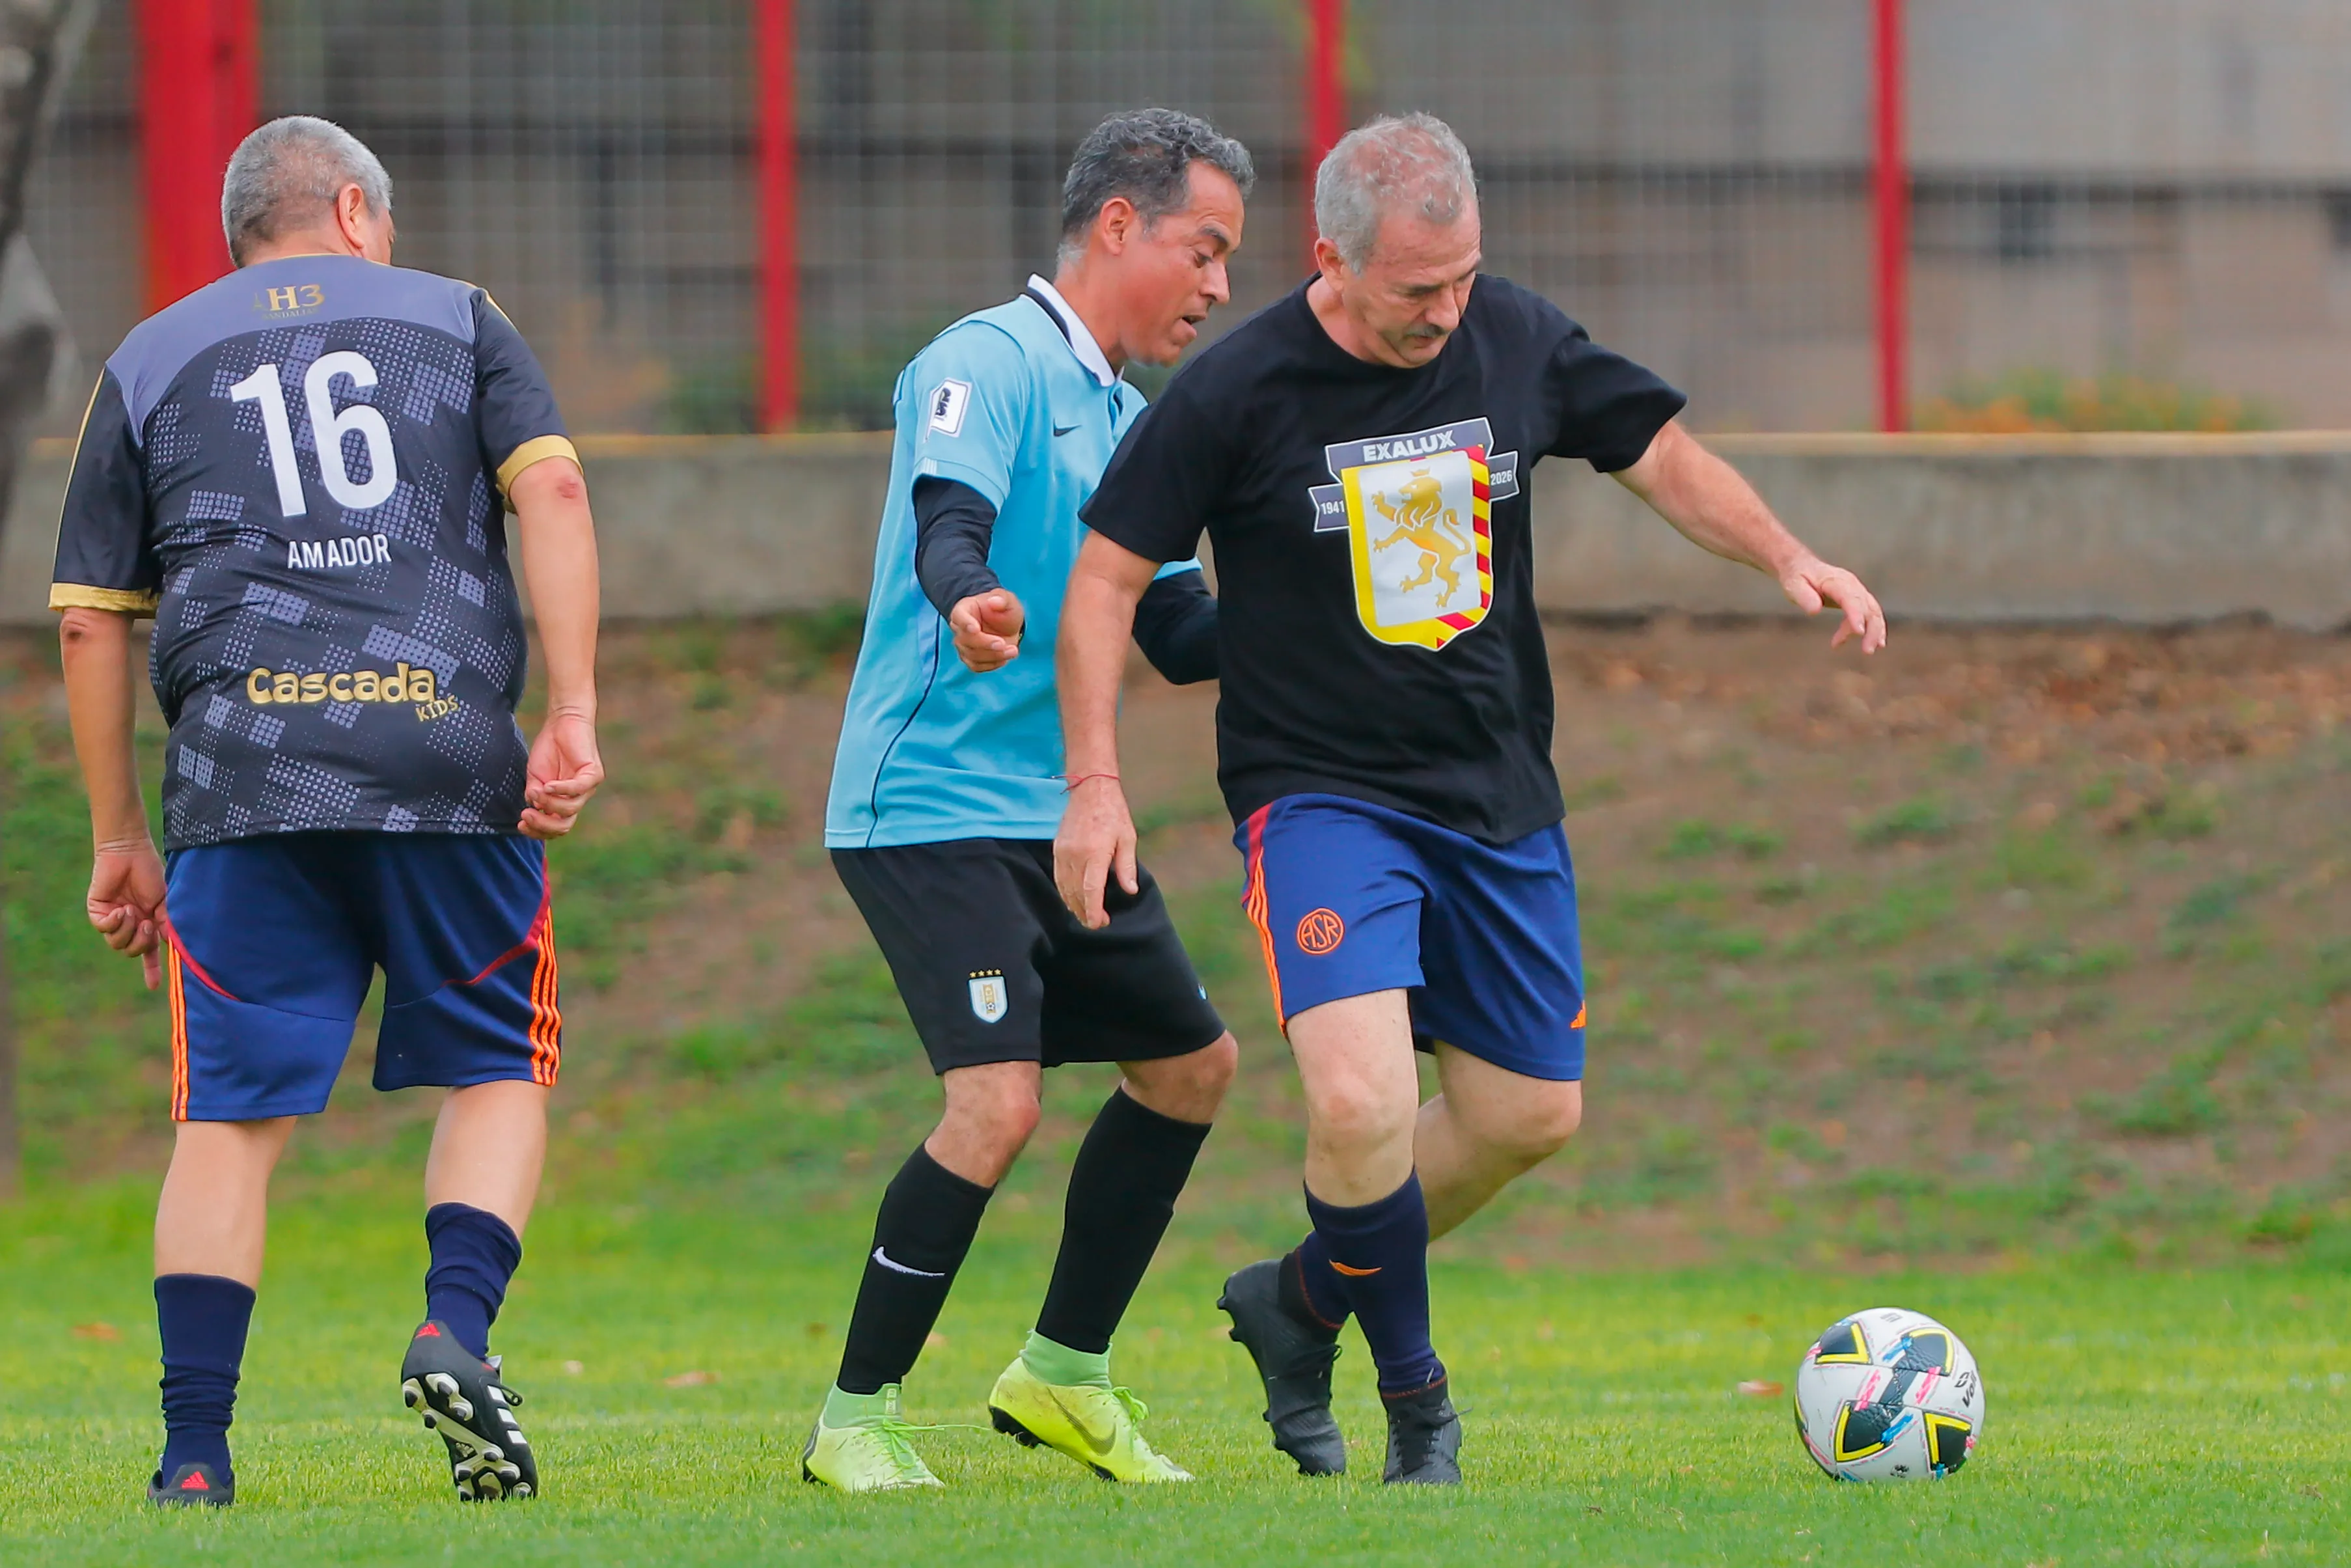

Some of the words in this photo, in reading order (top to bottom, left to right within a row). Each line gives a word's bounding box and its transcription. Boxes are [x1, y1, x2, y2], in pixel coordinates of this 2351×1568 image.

[266, 284, 325, 311] H3
[230, 350, 398, 517] 16
[1363, 430, 1457, 462] EXALUX
[1491, 469, 1513, 486] 2026
[1320, 500, 1345, 515] 1941
[288, 533, 392, 569] AMADOR
[247, 661, 435, 704] Cascada
[415, 695, 459, 722] KIDS
[1301, 914, 1340, 948] ASR
